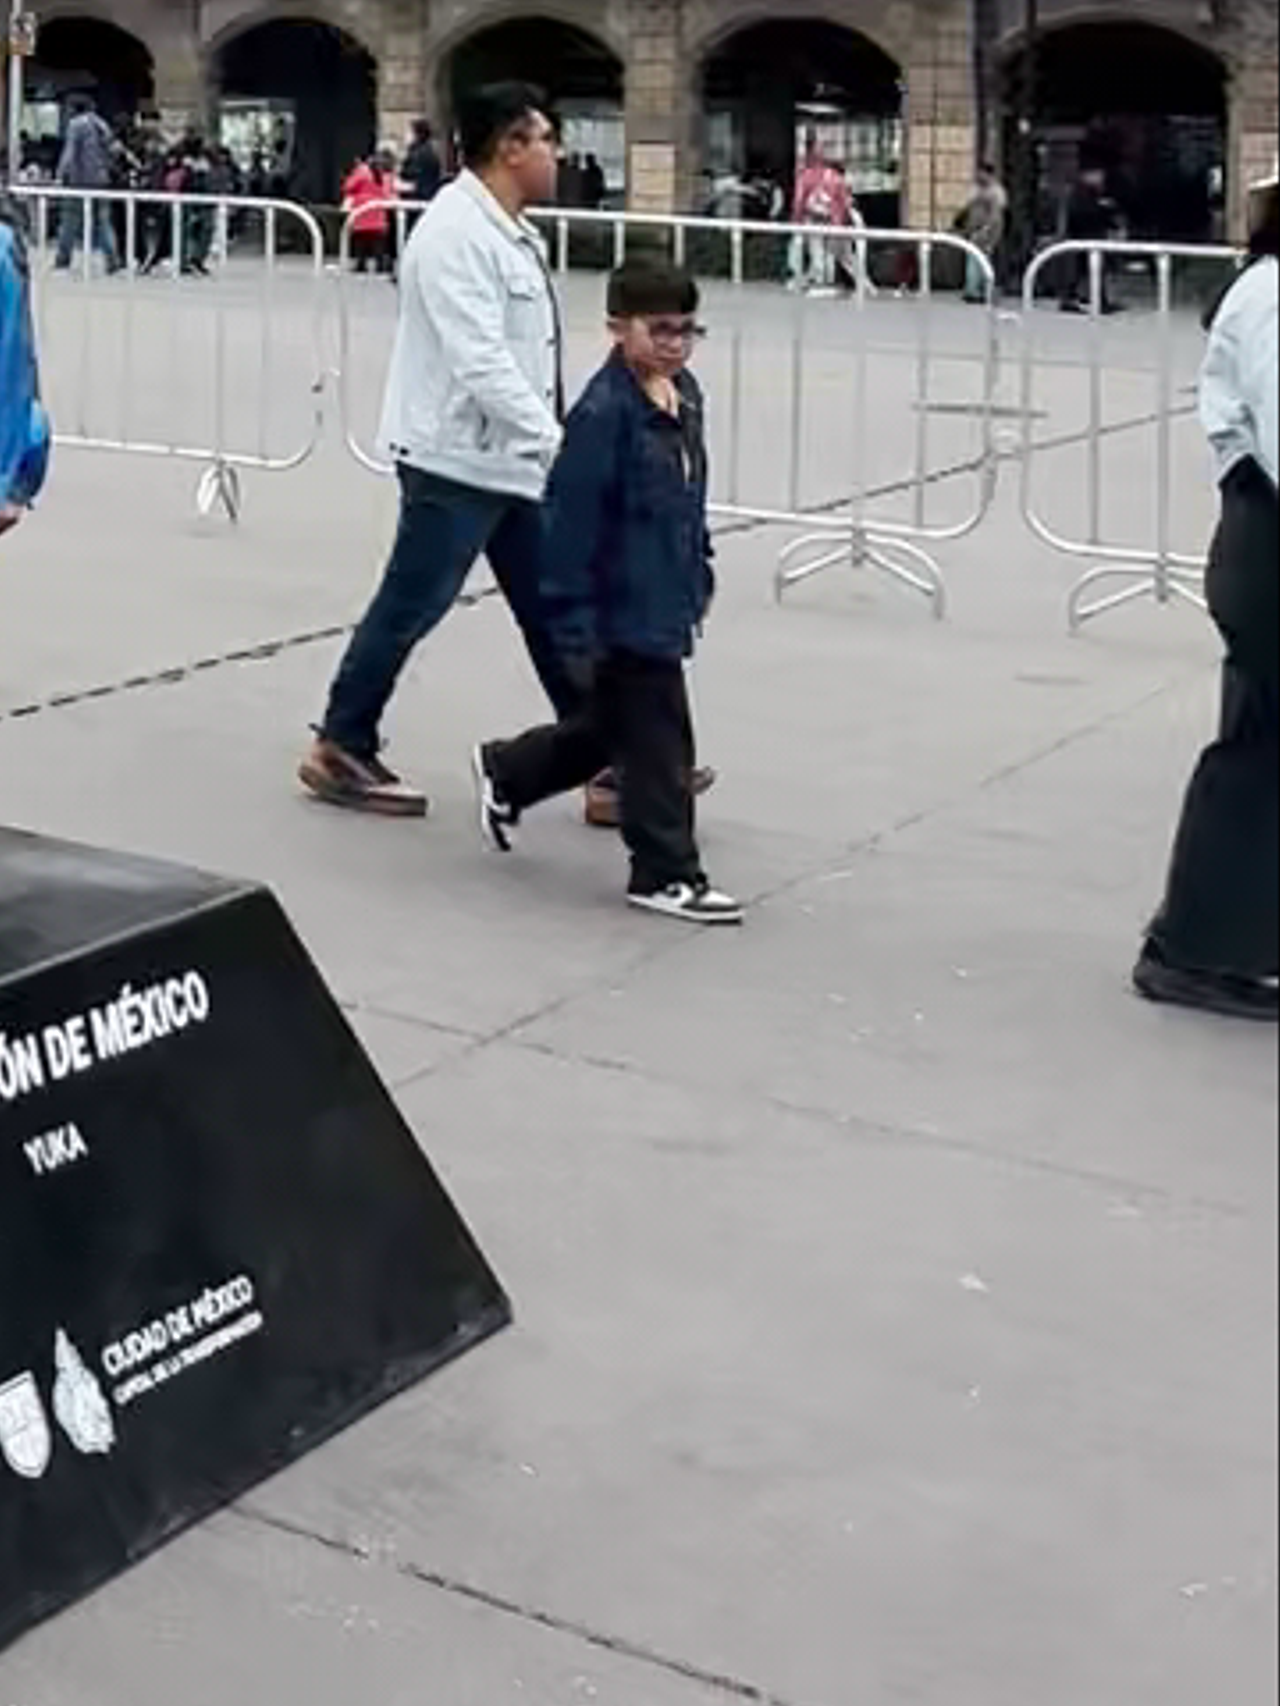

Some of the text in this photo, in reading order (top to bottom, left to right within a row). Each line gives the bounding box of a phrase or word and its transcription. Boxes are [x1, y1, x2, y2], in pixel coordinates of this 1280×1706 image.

[43, 1015, 93, 1080] DE
[90, 969, 210, 1060] MÉXICO
[22, 1122, 89, 1175] YUKA
[101, 1319, 168, 1377] CIUDAD
[165, 1305, 194, 1342] DE
[190, 1274, 254, 1329] MÉXICO
